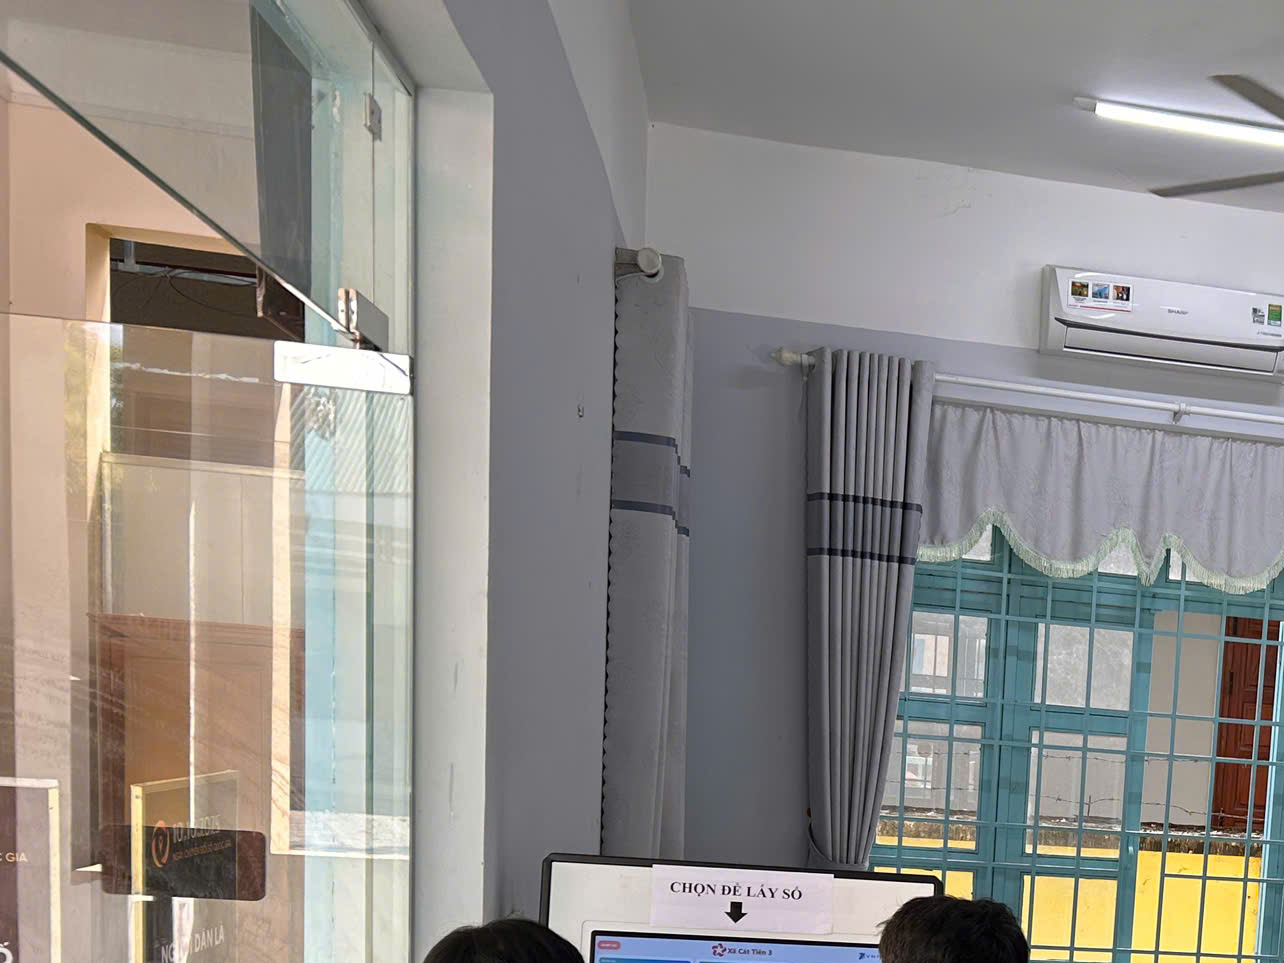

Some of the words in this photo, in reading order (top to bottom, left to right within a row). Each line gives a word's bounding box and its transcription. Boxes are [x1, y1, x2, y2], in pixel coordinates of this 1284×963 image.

[669, 881, 717, 897] CHỌN
[720, 882, 743, 897] ĐỂ
[746, 884, 779, 899] LẤY
